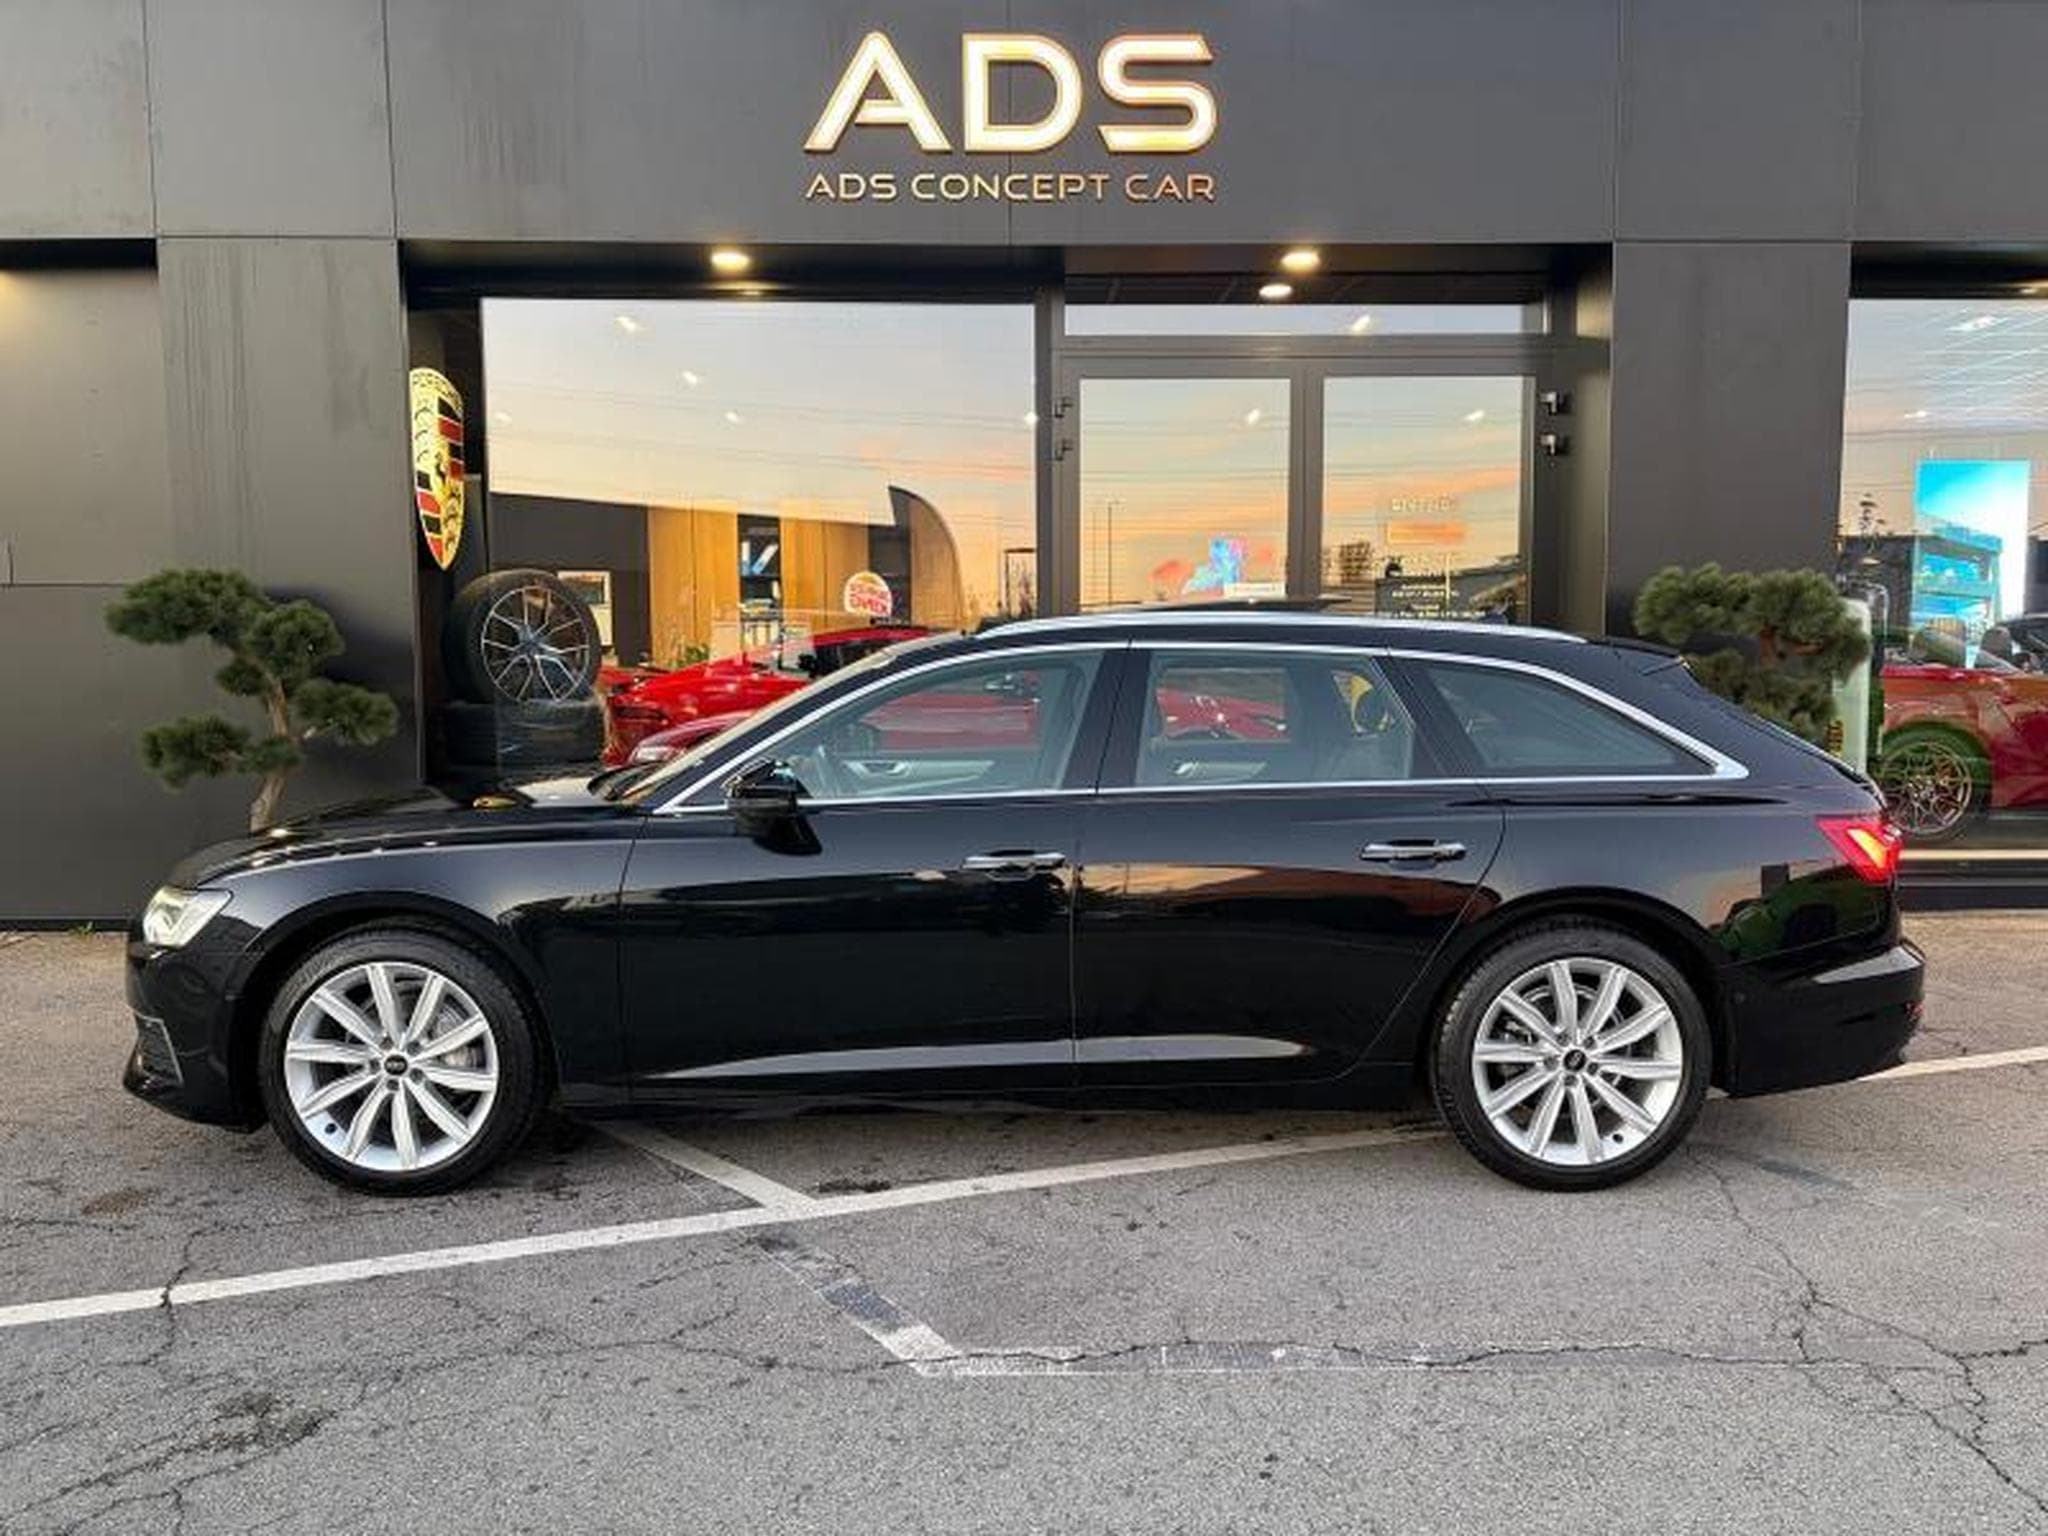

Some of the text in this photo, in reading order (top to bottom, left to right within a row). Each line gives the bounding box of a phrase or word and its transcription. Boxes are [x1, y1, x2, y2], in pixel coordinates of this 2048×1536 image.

[804, 30, 1217, 152] ADS
[805, 173, 1216, 201] ADS CONCEPT CAR
